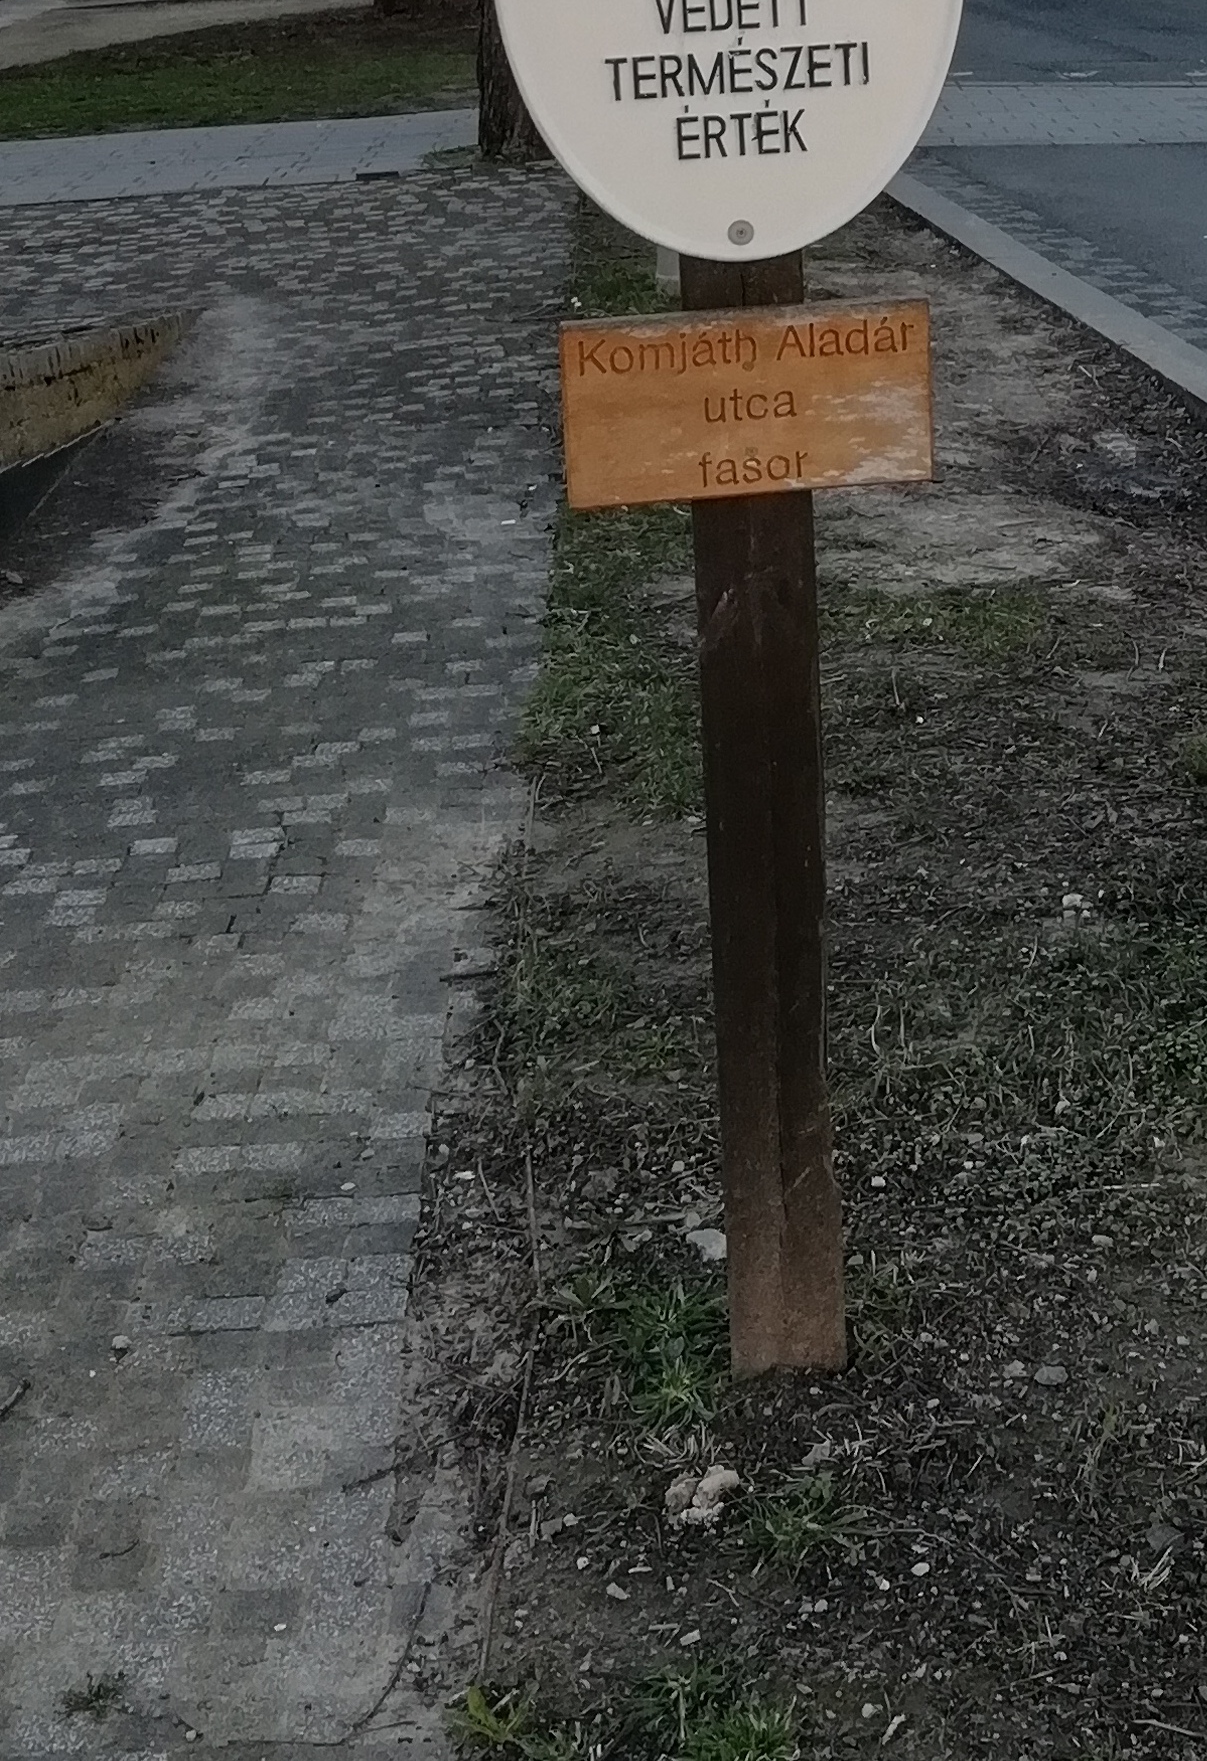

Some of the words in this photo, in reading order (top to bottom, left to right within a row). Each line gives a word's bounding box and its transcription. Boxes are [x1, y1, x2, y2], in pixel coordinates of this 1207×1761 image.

[604, 36, 871, 102] TERMÉSZETI
[675, 99, 809, 161] ÉRTÉK
[775, 316, 915, 362] Aladár
[703, 388, 798, 424] utca
[698, 450, 809, 488] fasor
